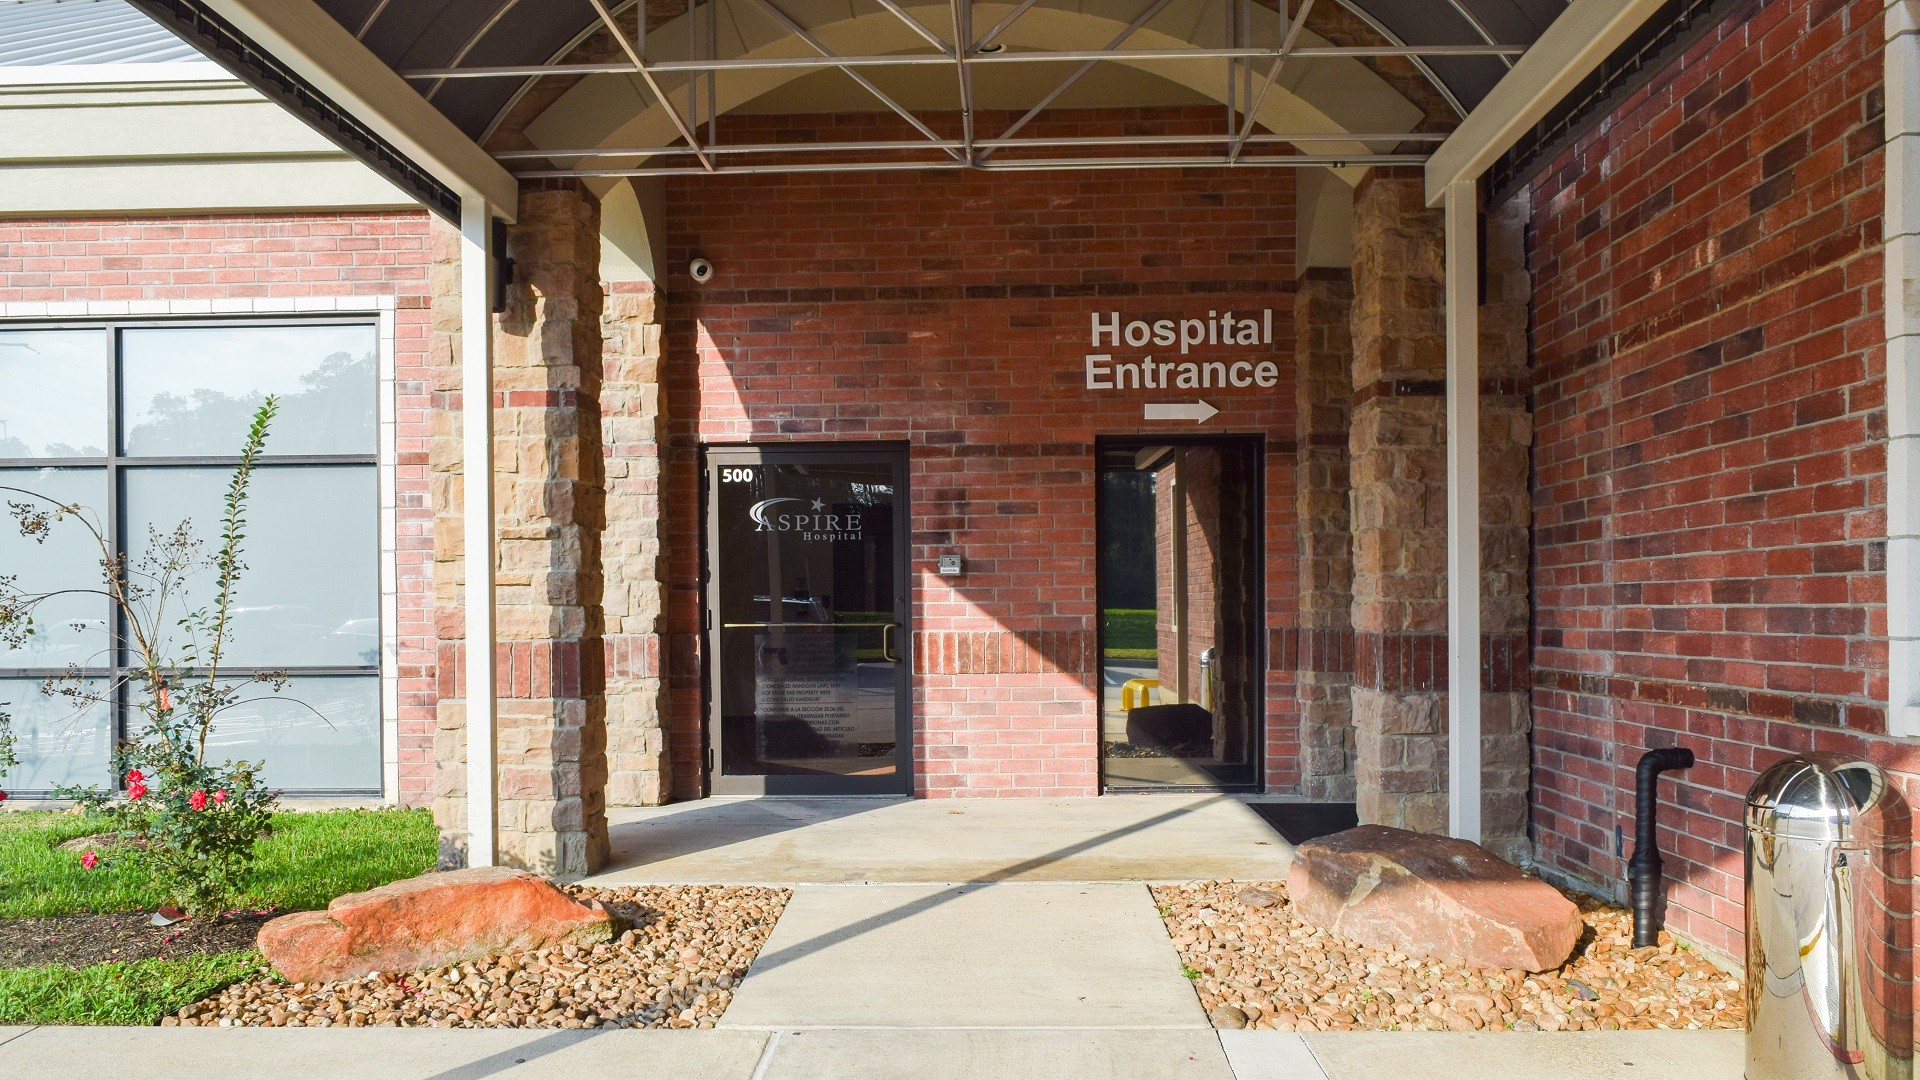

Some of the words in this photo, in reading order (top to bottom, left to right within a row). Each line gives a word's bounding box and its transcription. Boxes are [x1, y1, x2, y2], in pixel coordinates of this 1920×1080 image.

[1091, 308, 1273, 354] Hospital
[1085, 354, 1279, 389] Entrance
[722, 468, 754, 483] 500
[755, 514, 862, 532] ASPIRE
[803, 531, 862, 542] Hospital
